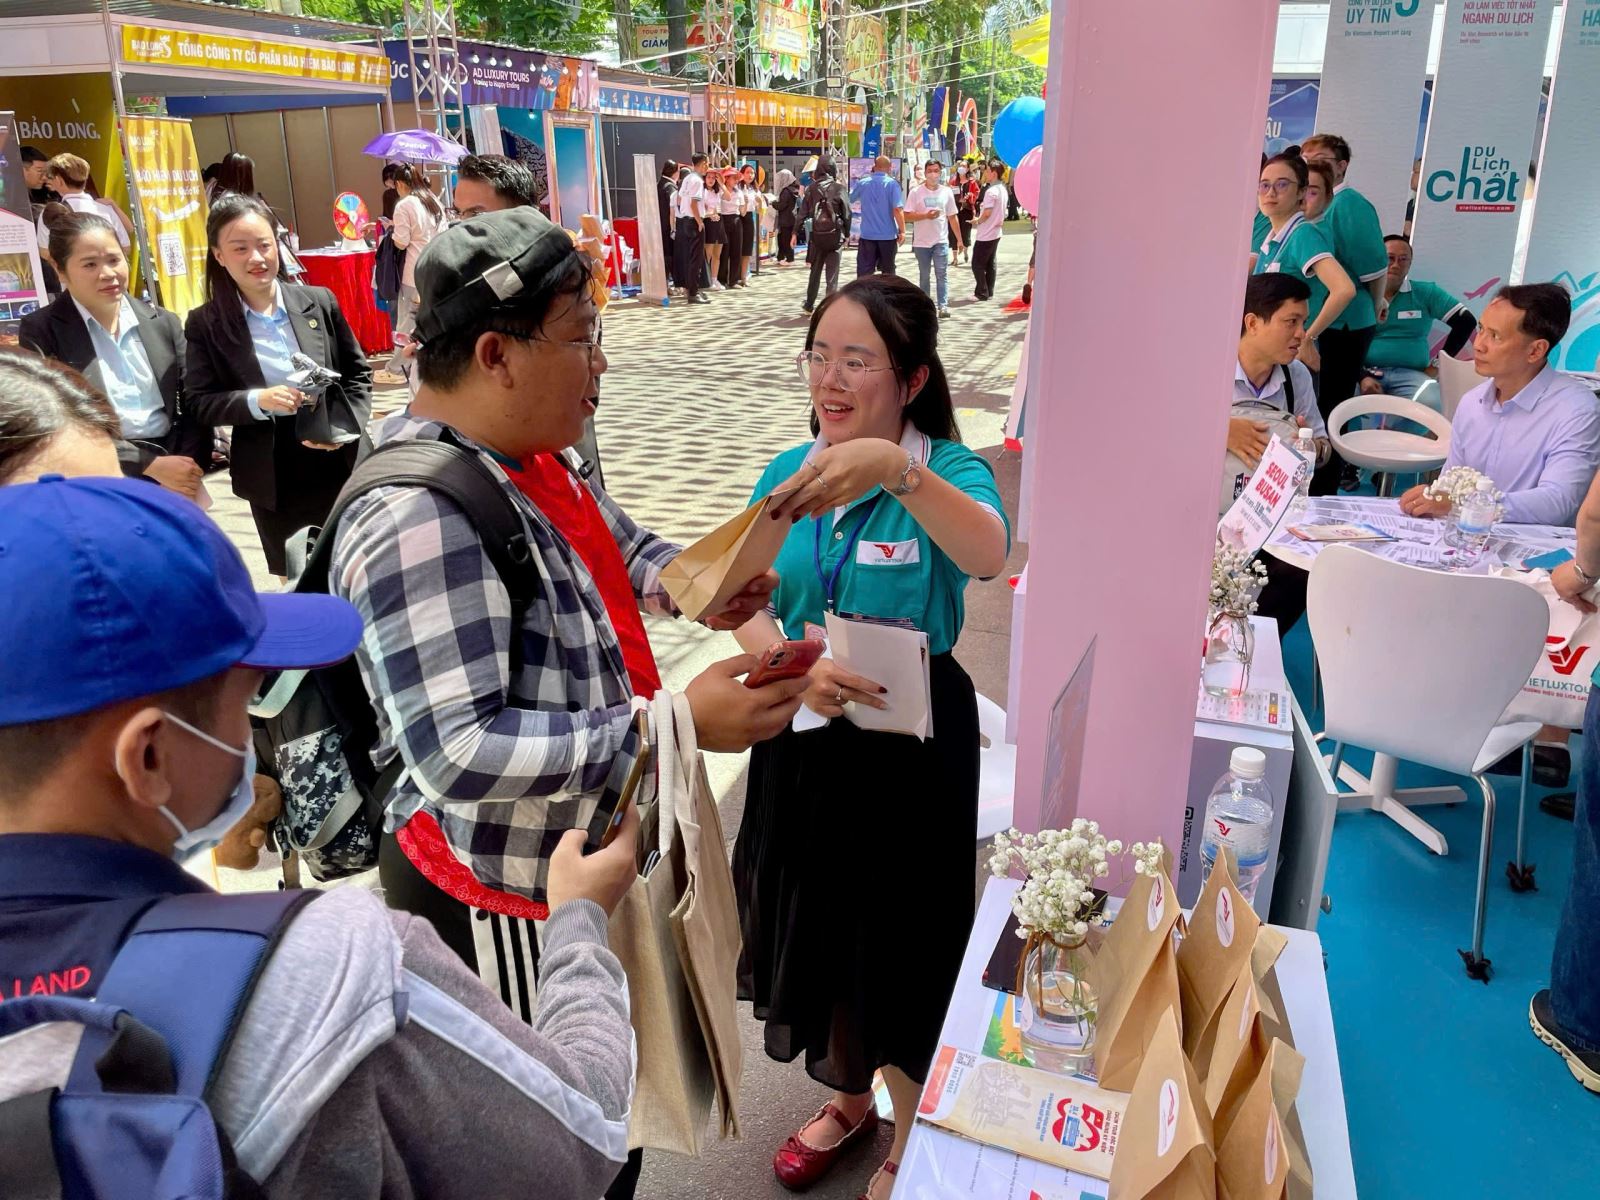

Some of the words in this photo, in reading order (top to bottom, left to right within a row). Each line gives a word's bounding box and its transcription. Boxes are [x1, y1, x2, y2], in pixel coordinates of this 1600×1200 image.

[1346, 8, 1365, 24] UY
[1497, 12, 1511, 24] DU
[205, 43, 230, 61] CÔNG
[232, 48, 243, 62] TY
[473, 67, 483, 78] AD
[483, 69, 509, 81] LUXURY
[509, 71, 530, 83] TOURS
[20, 115, 53, 139] BẢO
[786, 126, 829, 141] VISA
[1474, 146, 1496, 158] DU
[1426, 146, 1520, 203] chất
[1265, 461, 1289, 490] SEOUL
[1255, 478, 1281, 508] BUSAN
